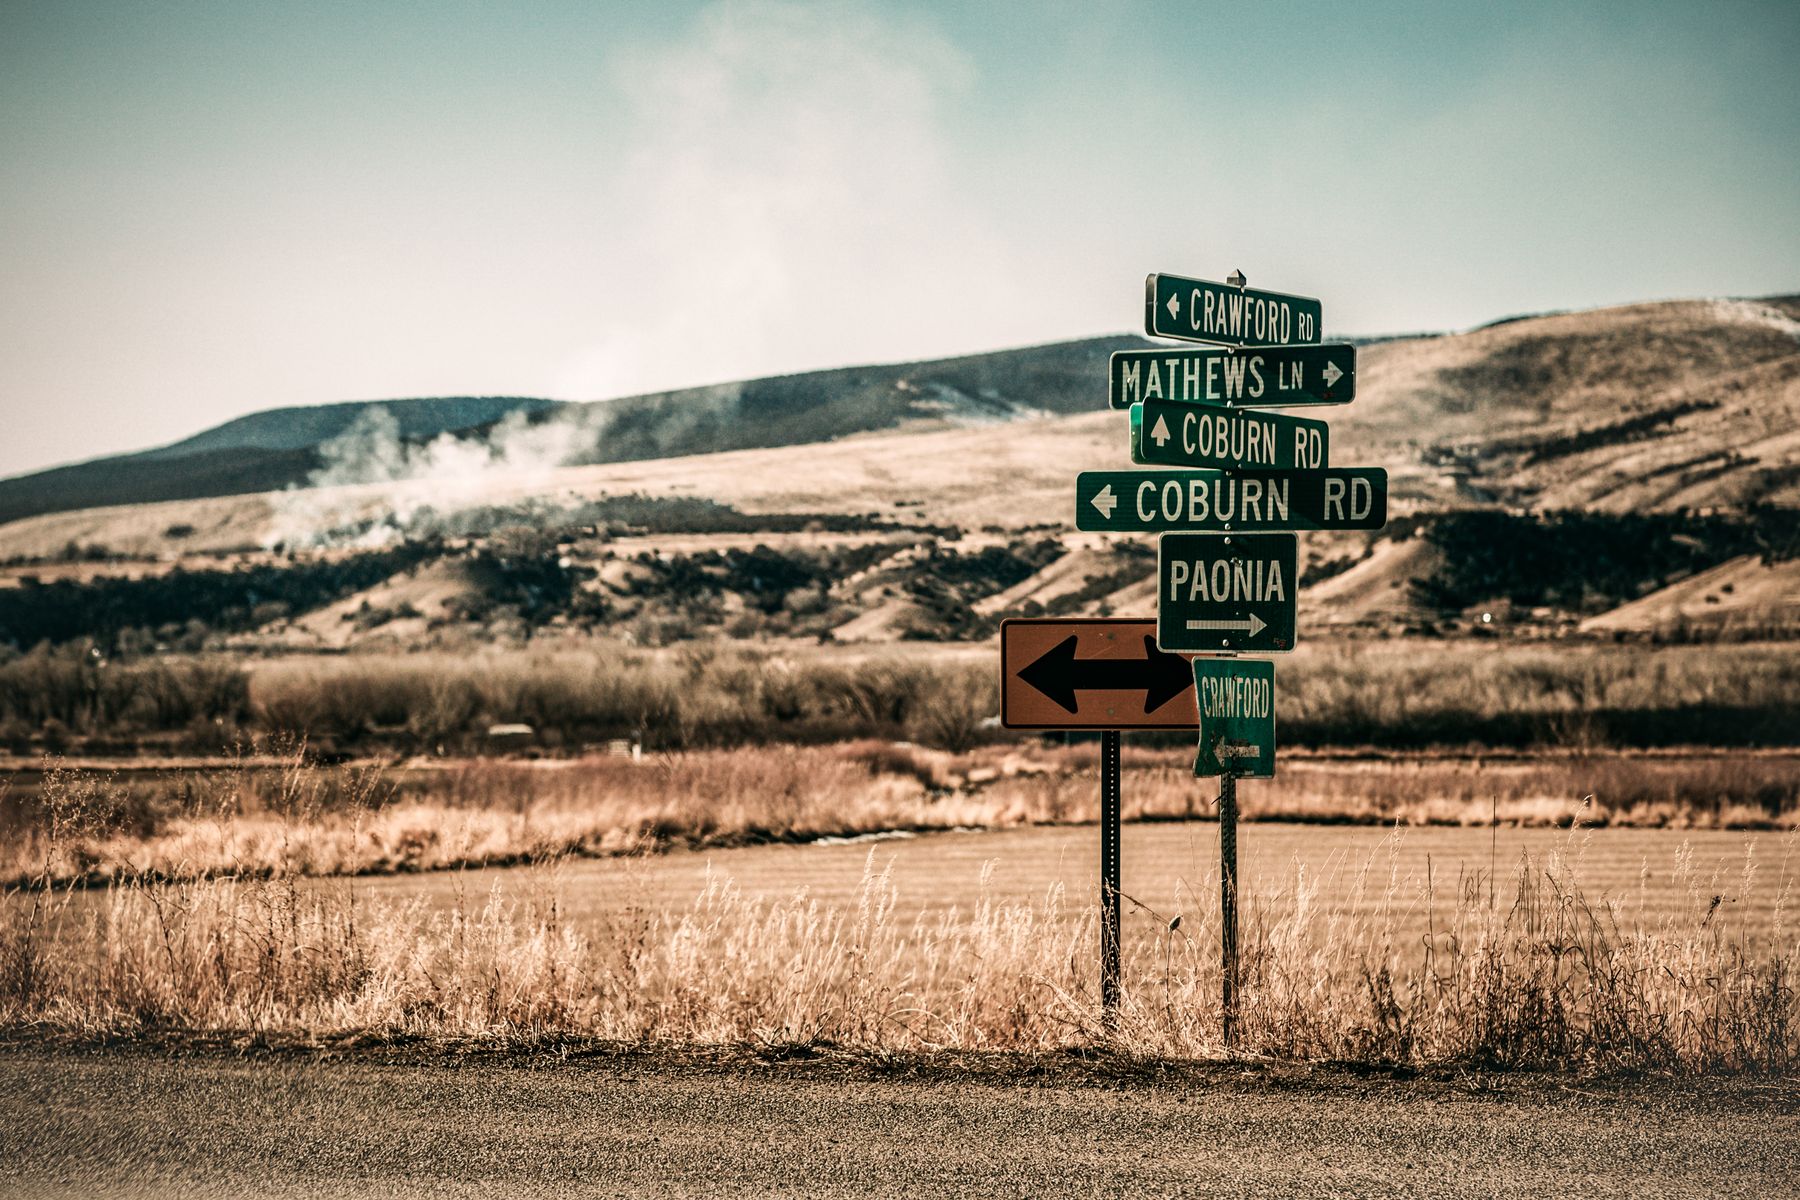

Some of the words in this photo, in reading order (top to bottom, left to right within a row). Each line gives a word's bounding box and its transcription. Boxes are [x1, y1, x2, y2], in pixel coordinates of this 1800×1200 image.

[1190, 288, 1291, 344] CRAWFORD
[1298, 312, 1313, 342] RD
[1122, 356, 1265, 402] MATHEWS
[1279, 361, 1304, 390] LN
[1183, 412, 1276, 465] COBURN
[1295, 427, 1322, 469] RD
[1136, 478, 1289, 522] COBURN
[1323, 477, 1373, 520] RD
[1171, 559, 1285, 602] PAONIA
[1202, 676, 1269, 719] CRAWFORD
